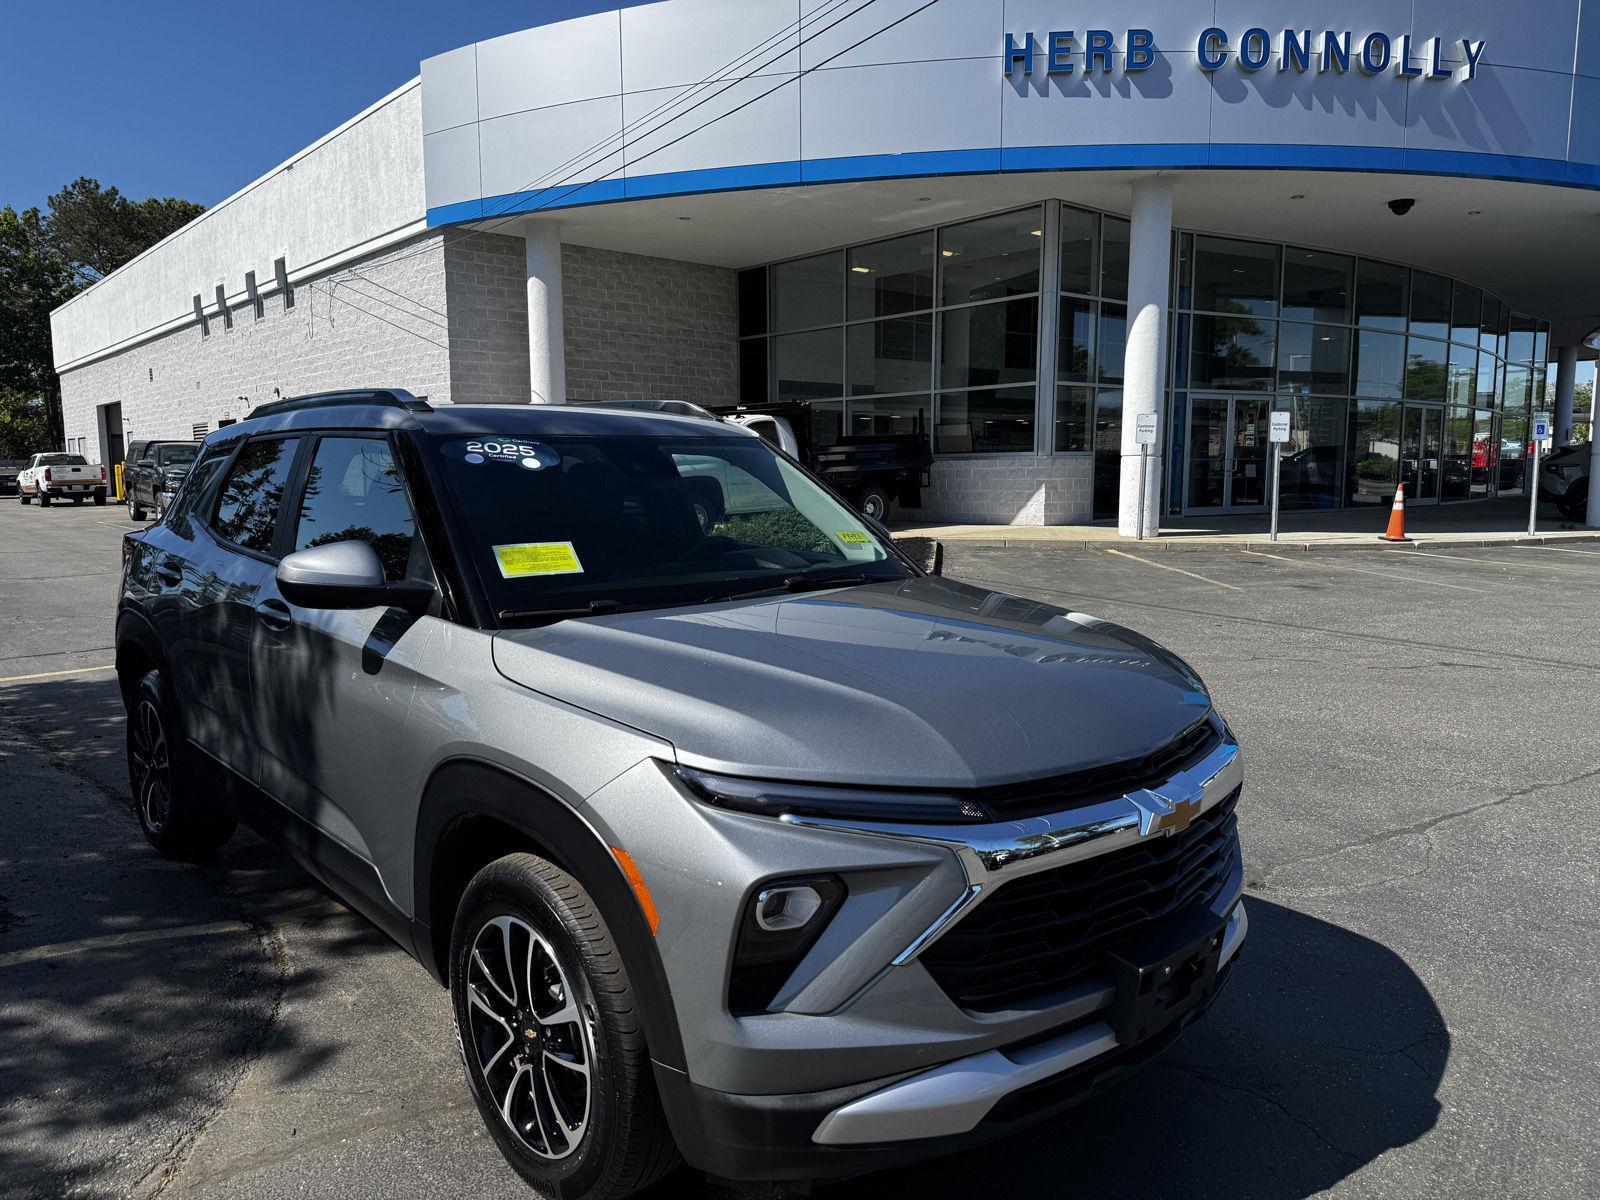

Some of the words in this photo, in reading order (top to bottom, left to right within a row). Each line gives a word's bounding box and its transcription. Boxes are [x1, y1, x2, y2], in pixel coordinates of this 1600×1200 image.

[1003, 28, 1157, 76] HERB
[1193, 27, 1486, 81] CONNOLLY
[466, 441, 535, 456] 2025
